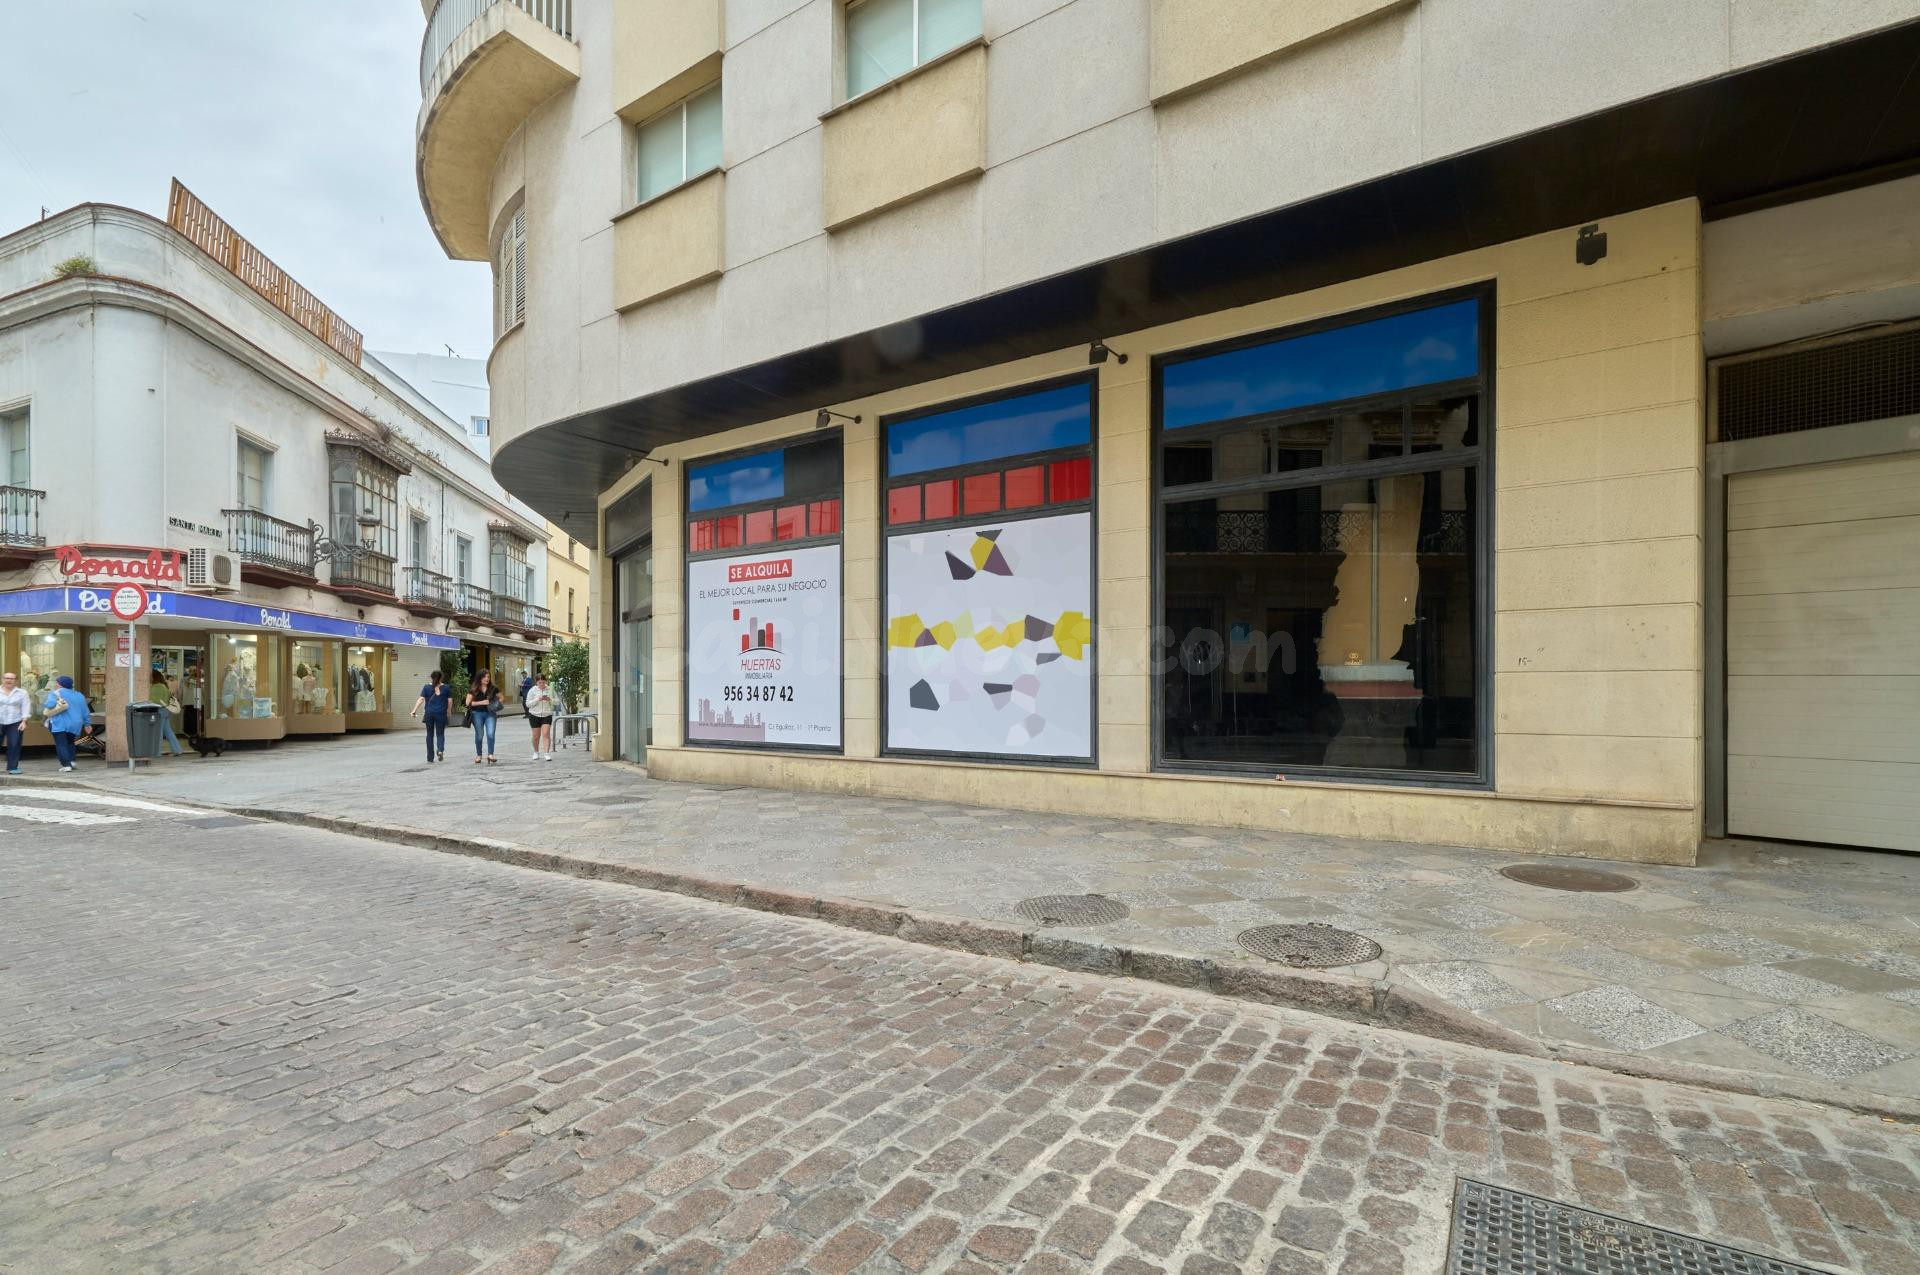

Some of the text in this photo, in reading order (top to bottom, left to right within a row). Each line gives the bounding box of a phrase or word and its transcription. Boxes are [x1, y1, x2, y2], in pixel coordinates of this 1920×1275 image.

[169, 516, 196, 532] SANTA
[55, 545, 182, 582] Donald
[731, 562, 789, 579] SE ALQUILA
[699, 579, 828, 599] EL MEJOR LOCAL PARA SU NEGOCIO
[261, 608, 291, 628] Donald
[740, 658, 781, 671] HUERTAS
[724, 685, 794, 702] 956 34 87 42
